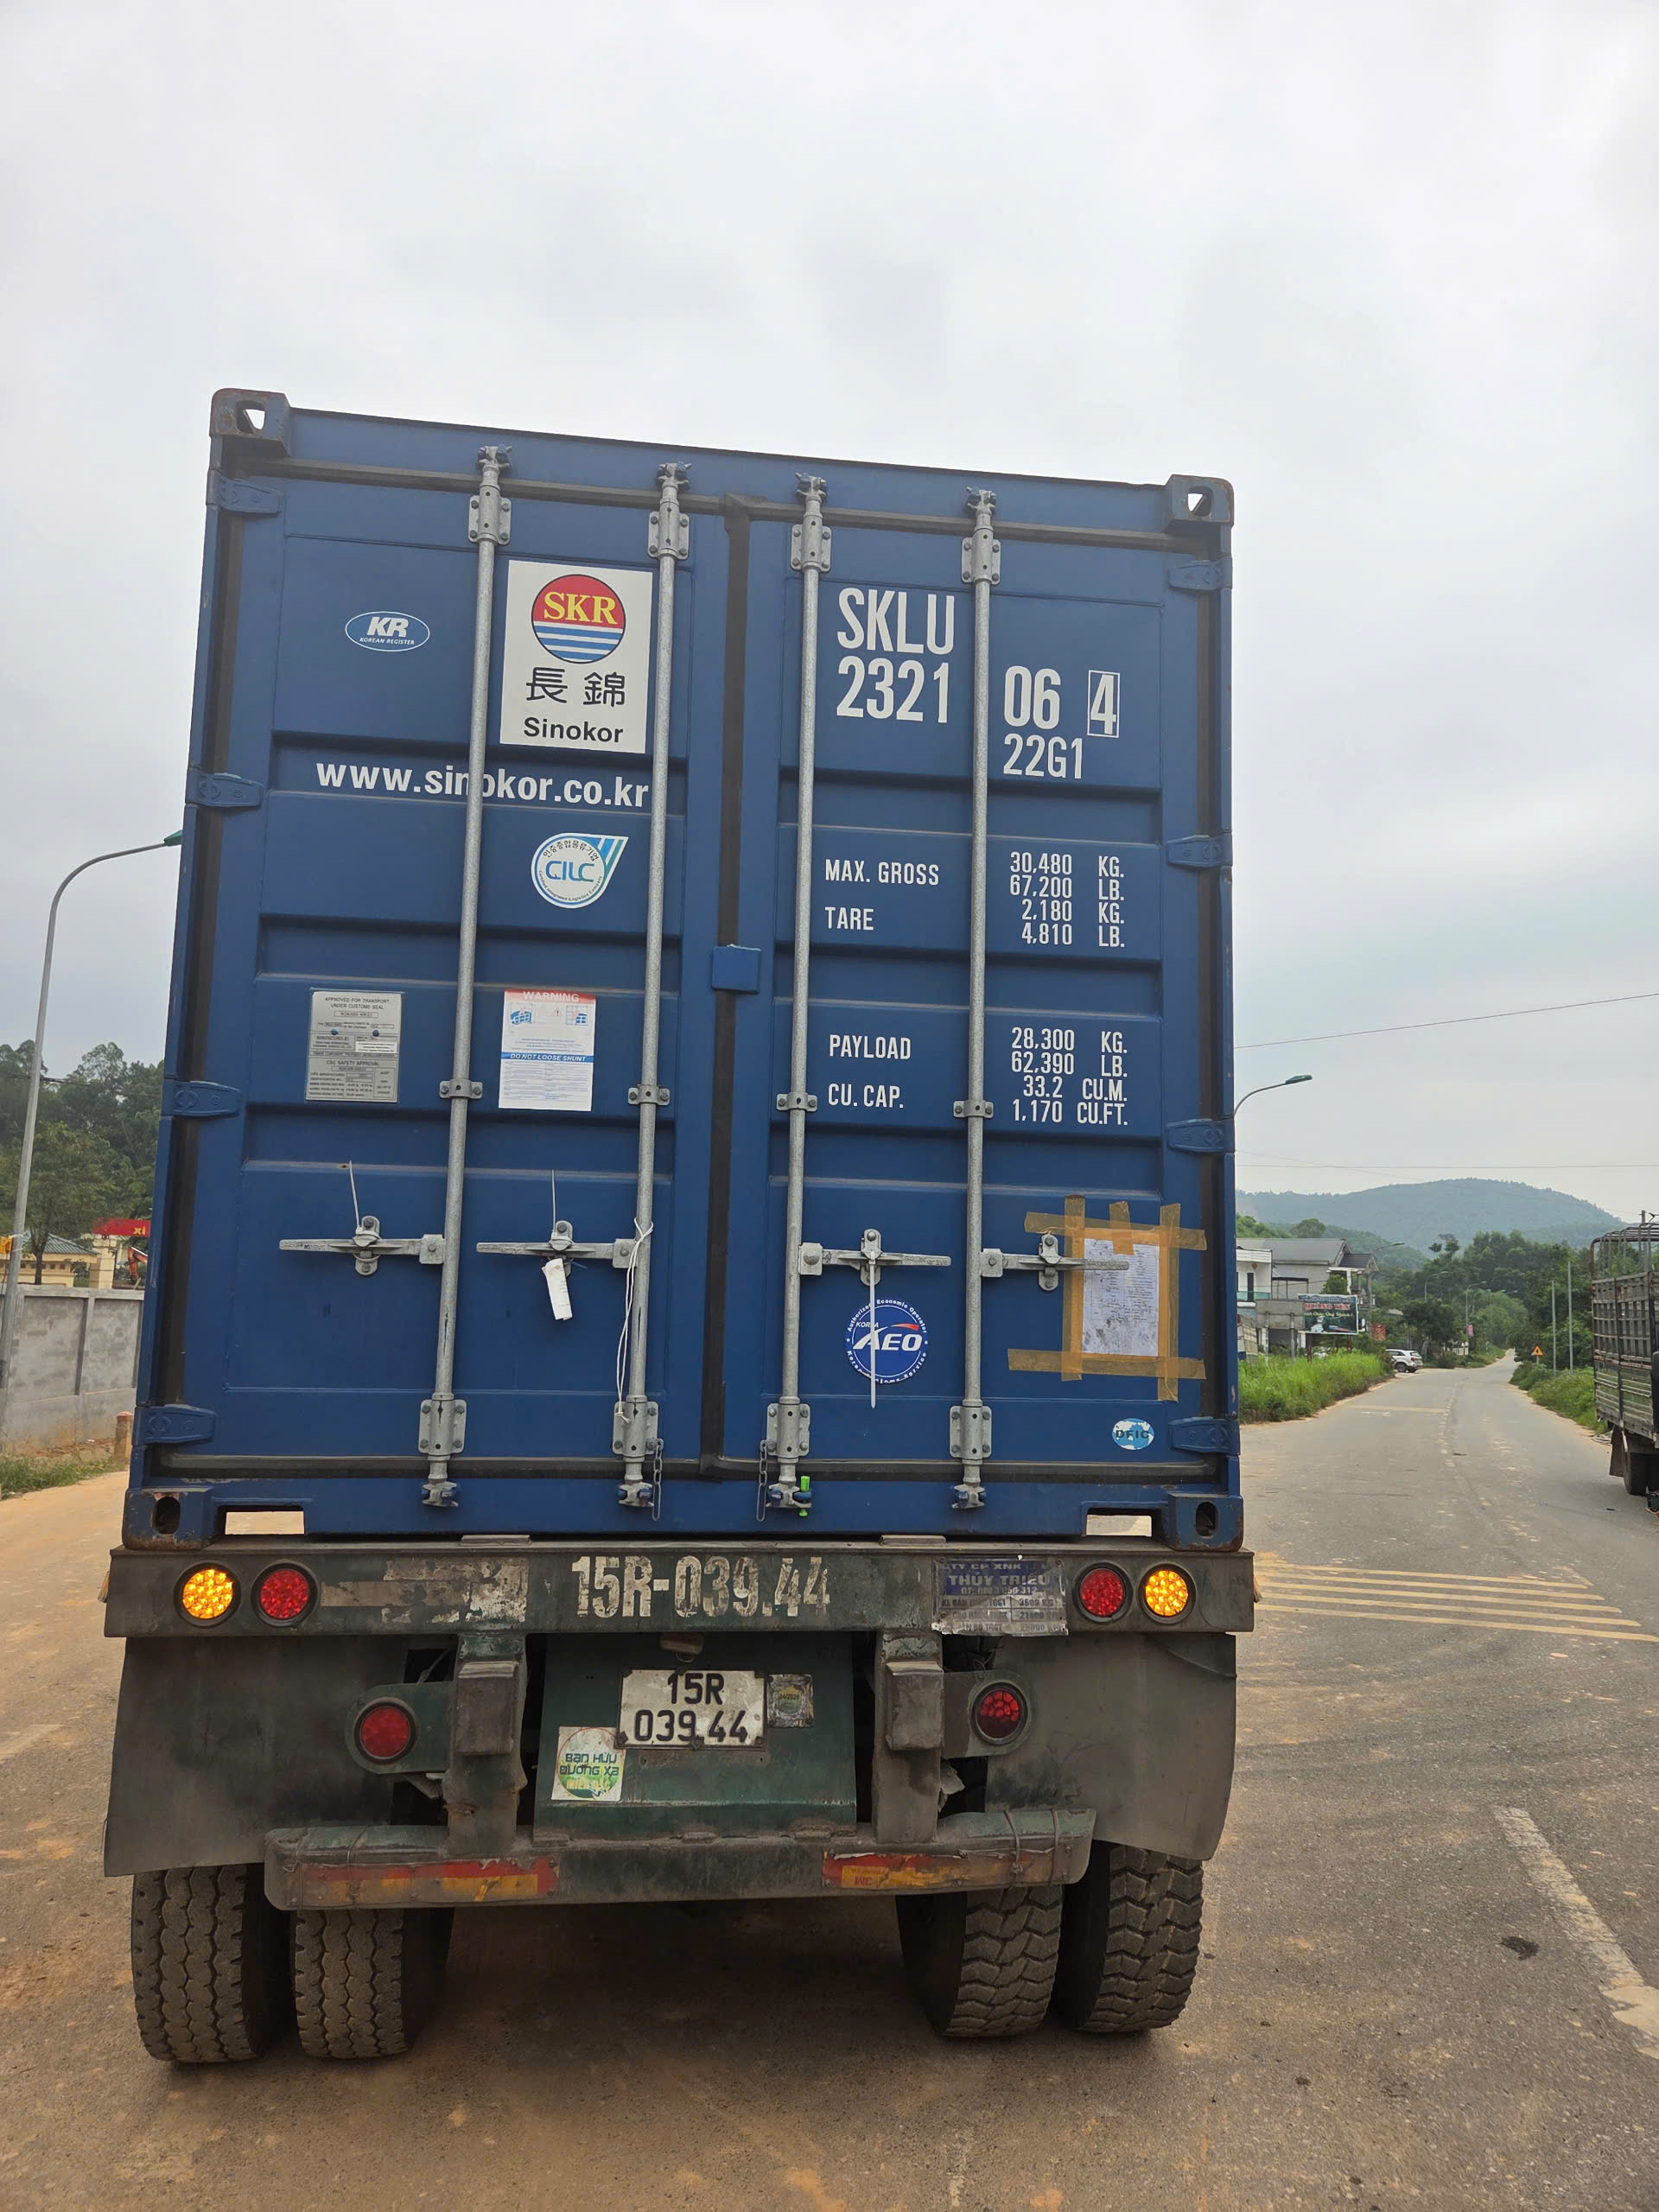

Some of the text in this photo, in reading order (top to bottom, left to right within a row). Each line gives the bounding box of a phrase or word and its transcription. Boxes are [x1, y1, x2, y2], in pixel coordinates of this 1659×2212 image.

[543, 591, 619, 627] SKR
[836, 588, 955, 655] SKLU
[367, 617, 409, 638] KR
[836, 656, 1117, 735] 2321 06 4
[524, 717, 625, 744] Sinokor
[1003, 733, 1084, 779] 22G1
[545, 861, 594, 882] CILC
[824, 859, 939, 887] MAX. GROSS
[1009, 852, 1124, 879] 30,480 KG.
[1009, 875, 1124, 902] 67,200 LB.
[824, 906, 874, 931] TARE
[1021, 899, 1125, 925] 2,180 KG.
[1021, 924, 1125, 948] 4,810 LB.
[523, 991, 580, 1002] WARNING
[829, 1035, 912, 1060] PAYLOAD
[1011, 1027, 1128, 1054] 28,300 KG.
[1011, 1052, 1128, 1078] 62,390 LB.
[828, 1084, 904, 1109] CU. CAP.
[1022, 1076, 1128, 1102] 33.2 CU.M.
[1012, 1100, 1128, 1126] 1,170 CU.FT.
[853, 1329, 923, 1351] AEO
[571, 1555, 830, 1618] 15R-039.44
[668, 1673, 724, 1705] 15R
